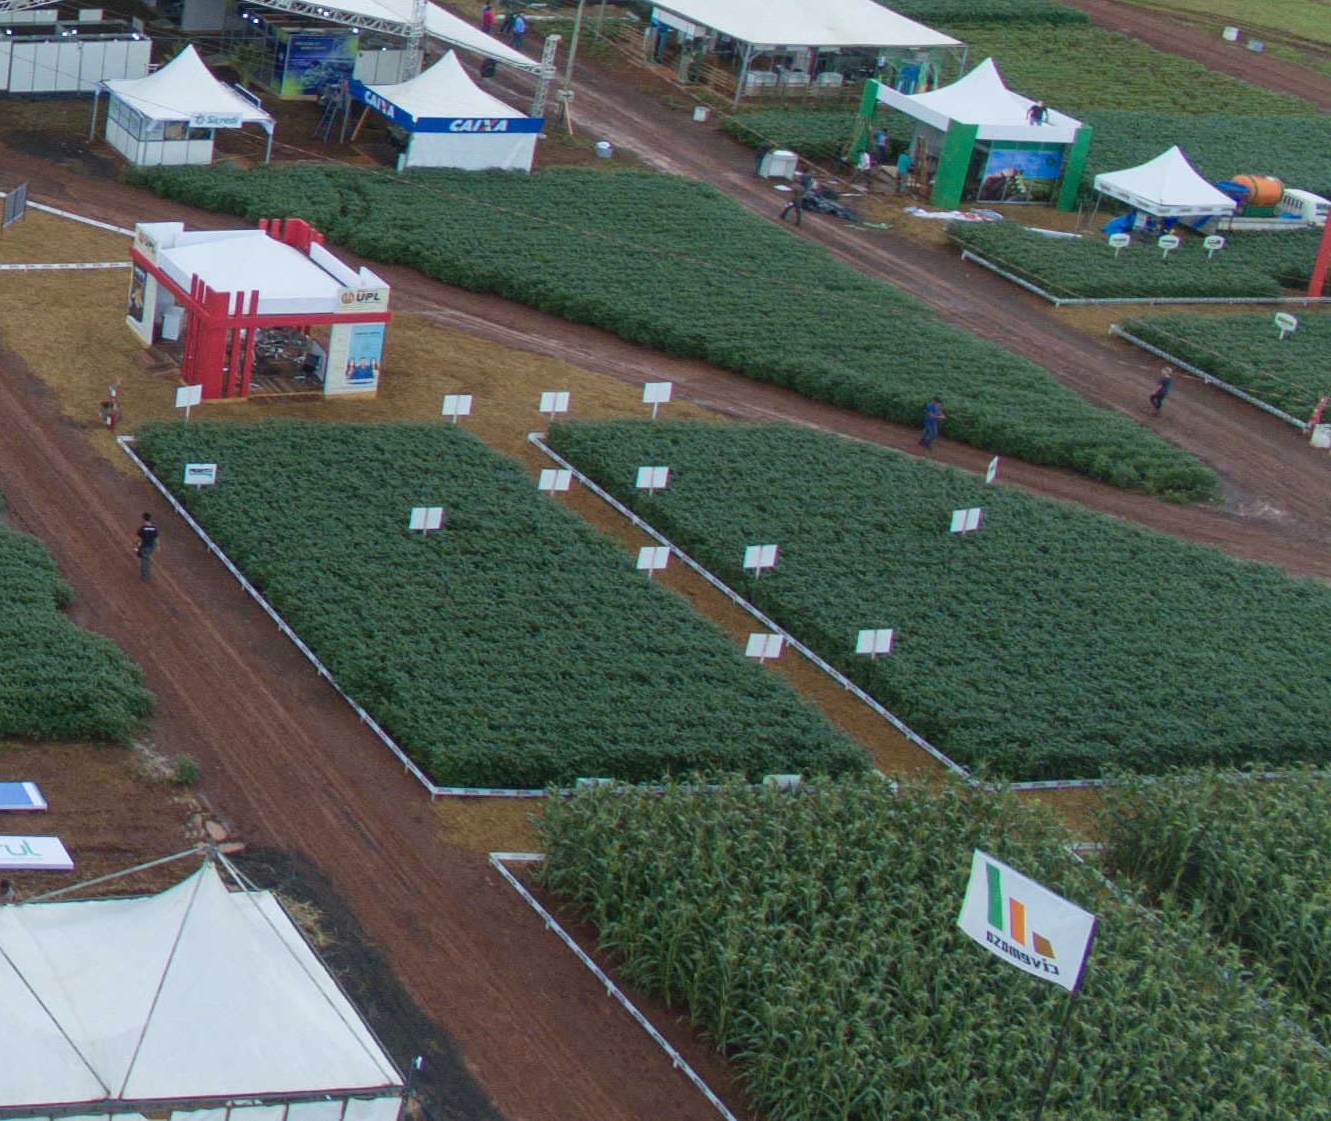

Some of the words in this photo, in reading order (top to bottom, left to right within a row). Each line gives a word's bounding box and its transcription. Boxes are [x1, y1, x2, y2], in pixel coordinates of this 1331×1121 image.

[364, 90, 394, 118] CAIXA
[207, 115, 238, 124] Sicredi
[449, 119, 508, 131] CAIXA
[356, 292, 380, 302] UPL
